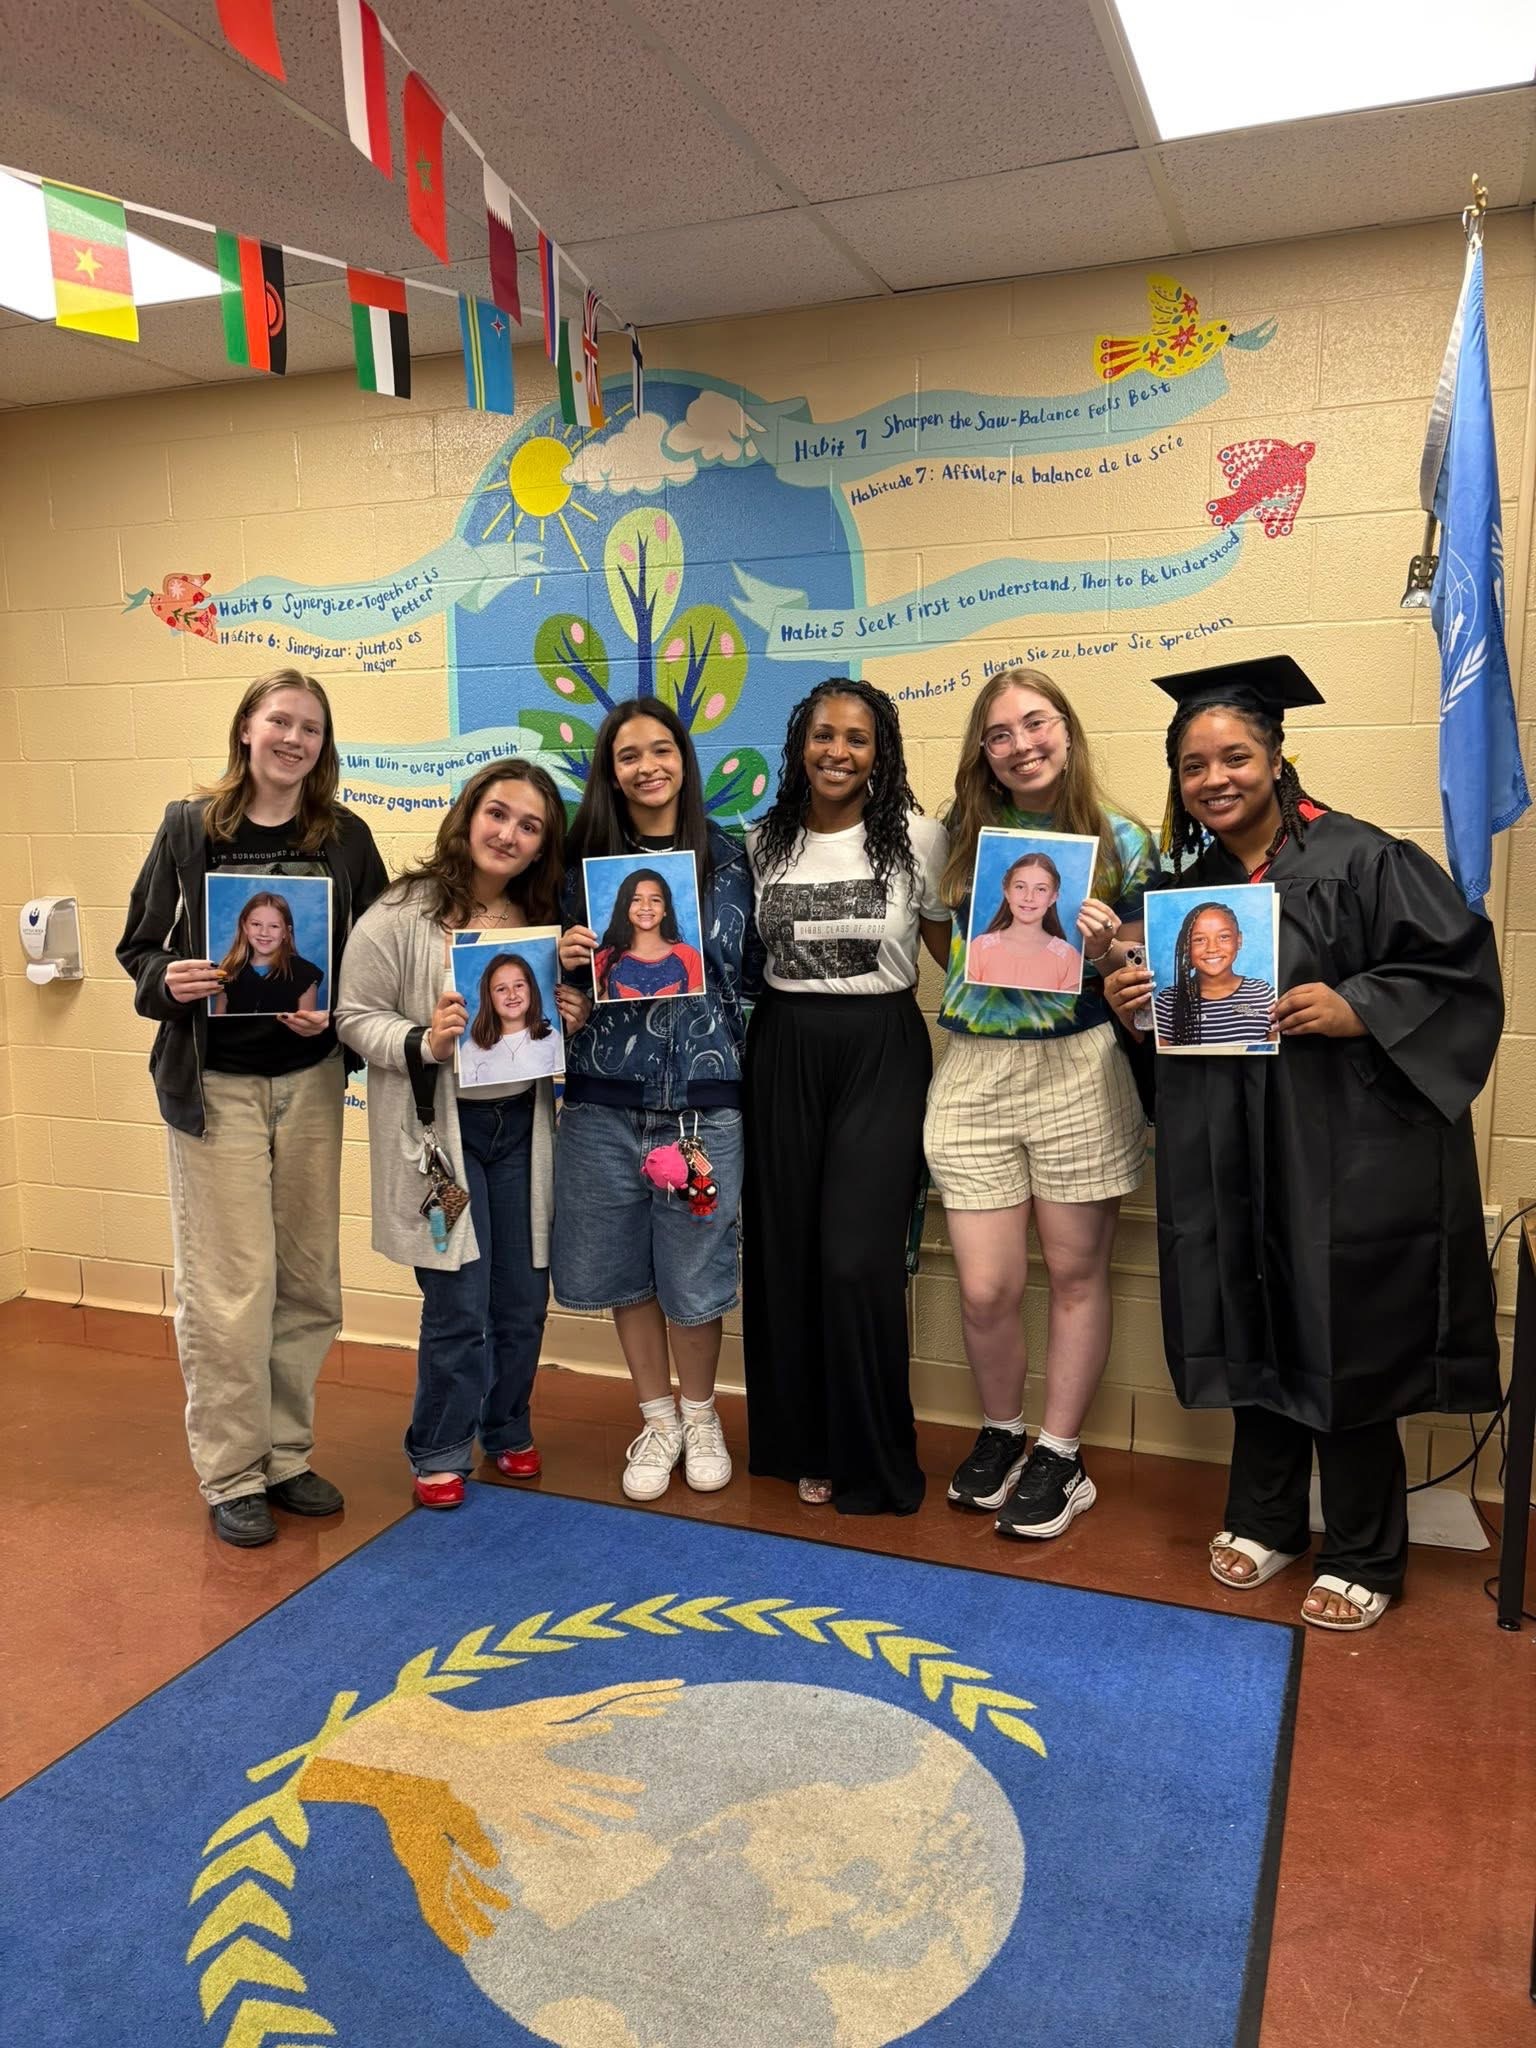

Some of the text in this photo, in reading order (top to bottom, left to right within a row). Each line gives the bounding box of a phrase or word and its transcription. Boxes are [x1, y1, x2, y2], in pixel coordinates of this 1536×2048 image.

[795, 437, 845, 462] Habit
[856, 429, 867, 449] 7
[881, 411, 943, 438] Sharpen
[948, 411, 972, 429] the
[1088, 397, 1120, 418] Feels
[1129, 382, 1171, 407] Best
[851, 475, 913, 505] Habitude
[1012, 470, 1024, 485] la
[1032, 466, 1093, 484] balance
[1099, 458, 1119, 474] de
[1126, 450, 1142, 467] la
[219, 598, 259, 617] Habit
[263, 594, 273, 610] 6
[424, 566, 439, 584] is
[781, 530, 1240, 642] Habit 5 Seek First to Understand, Then to Be Understood
[392, 587, 433, 622] Better
[355, 637, 403, 660] juntos
[408, 631, 422, 644] es
[961, 669, 971, 687] 5
[1027, 646, 1049, 662] Sie
[1128, 633, 1153, 649] Sie
[363, 658, 397, 673] mejor
[346, 754, 370, 769] Win
[465, 750, 490, 766] Can
[492, 742, 518, 757] Win
[343, 787, 386, 806] Pensez
[232, 850, 287, 860] SURROUNDED
[825, 925, 850, 934] CLASS
[853, 924, 862, 933] OF
